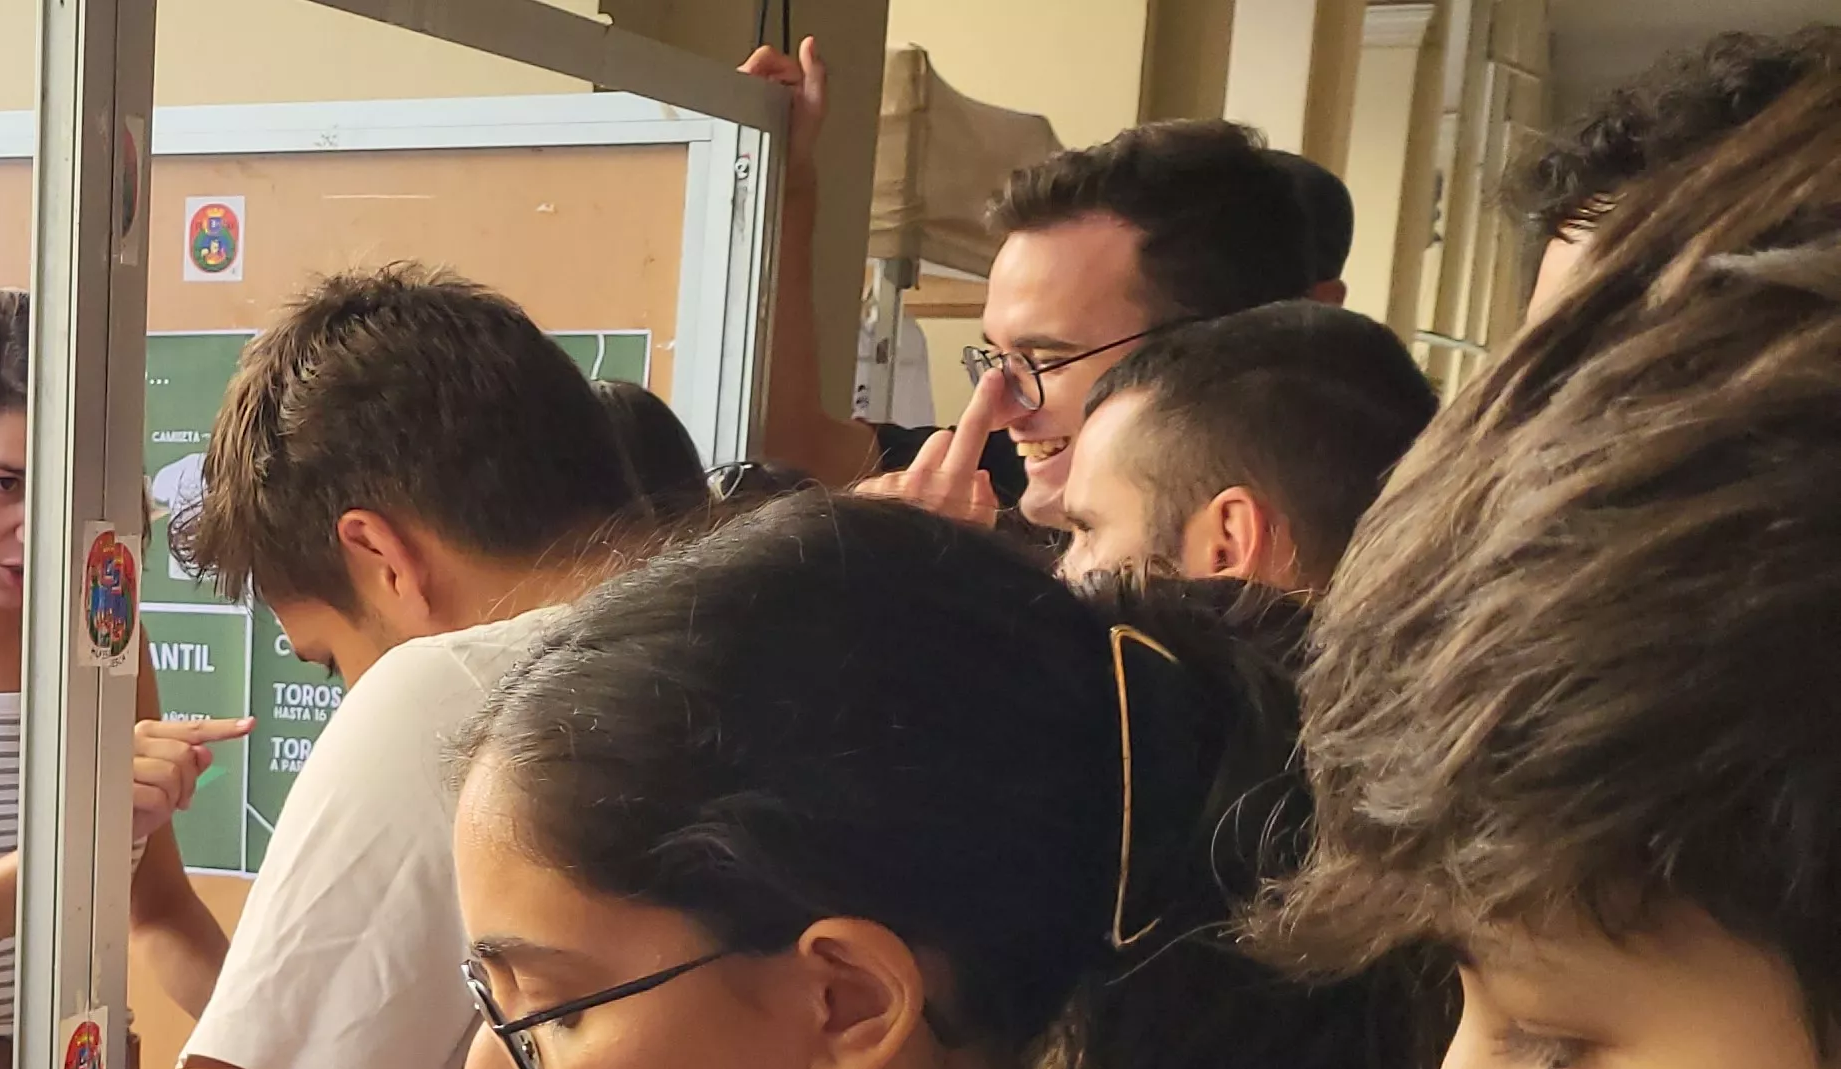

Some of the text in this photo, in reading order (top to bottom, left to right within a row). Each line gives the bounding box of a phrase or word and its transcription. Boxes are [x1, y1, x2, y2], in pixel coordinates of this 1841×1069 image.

[272, 682, 343, 709] TOROS
[273, 705, 311, 721] HASTA
[269, 758, 279, 772] A
